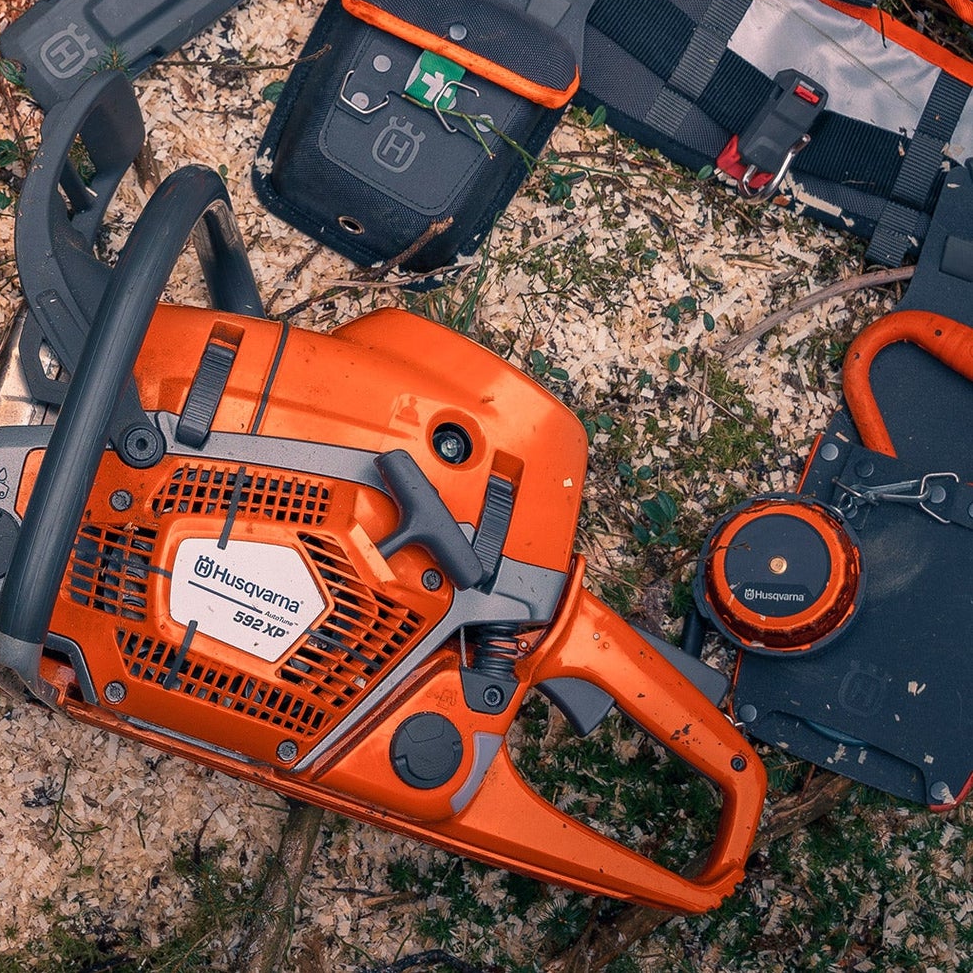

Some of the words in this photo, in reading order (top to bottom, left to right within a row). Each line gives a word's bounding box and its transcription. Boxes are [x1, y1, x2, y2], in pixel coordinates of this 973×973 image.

[212, 564, 301, 614] Husqvarna
[755, 590, 805, 602] Husqvarna
[233, 610, 264, 631] 592
[262, 623, 286, 639] XP
[264, 610, 294, 627] AutoTune
